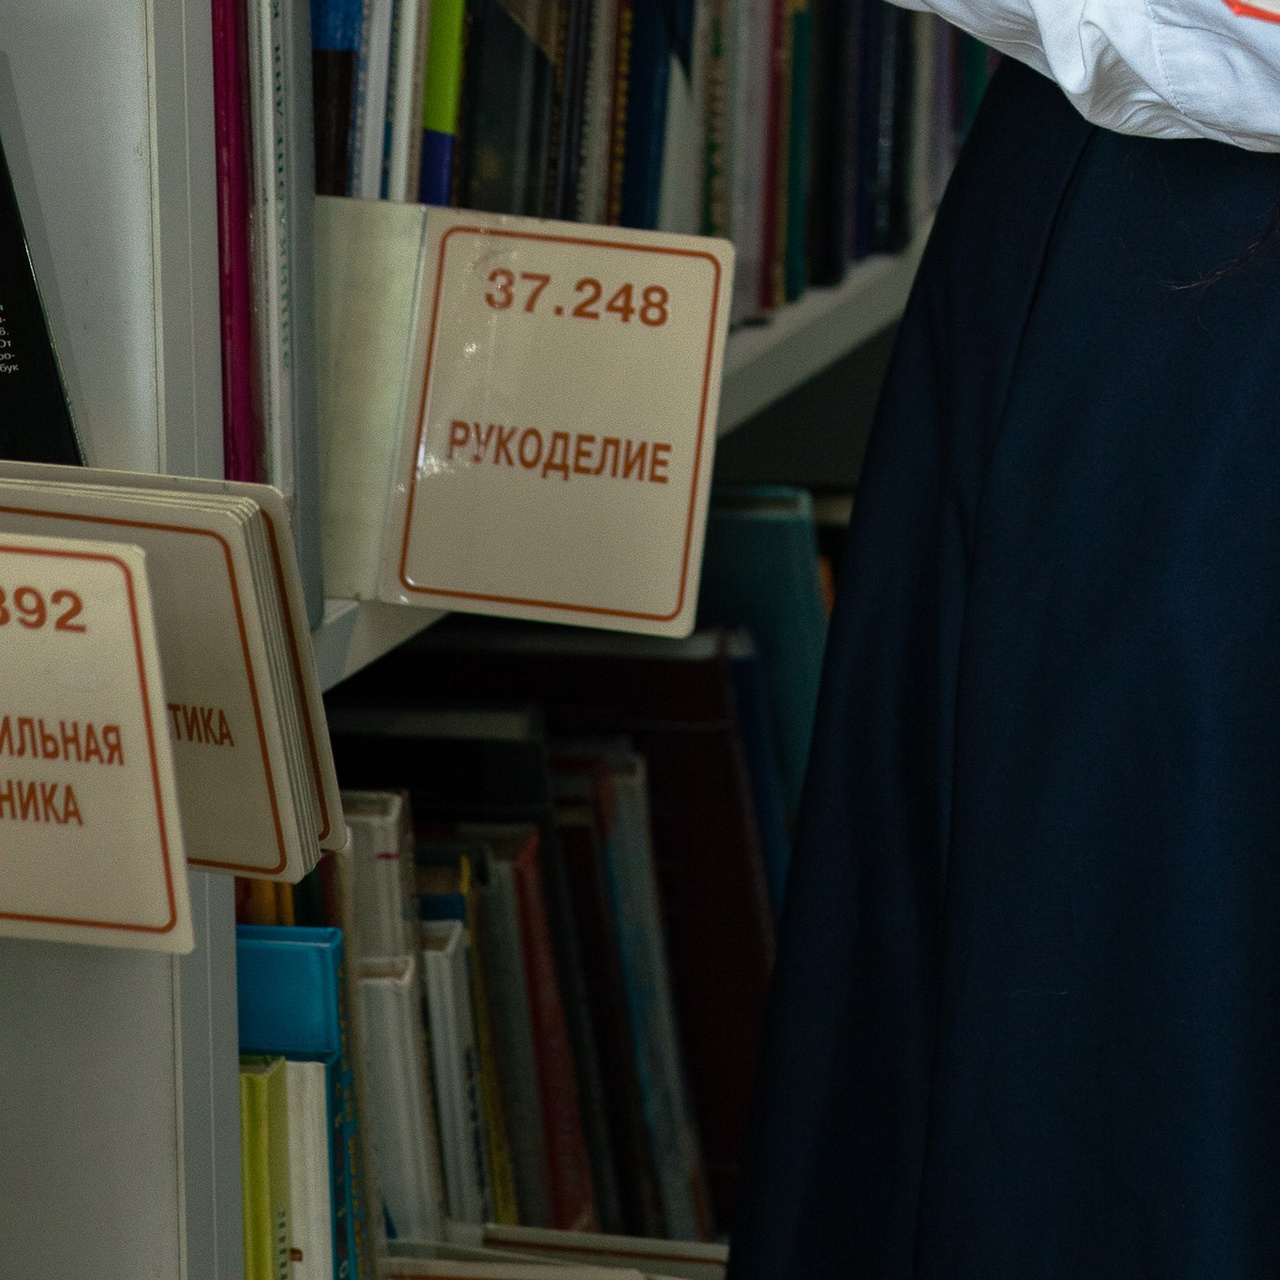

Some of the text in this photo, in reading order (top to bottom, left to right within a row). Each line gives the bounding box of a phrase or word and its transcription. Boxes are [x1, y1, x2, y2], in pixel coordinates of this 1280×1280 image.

[485, 268, 669, 328] 37.248
[449, 421, 671, 484] РУКОДЕЛИЕ
[167, 702, 235, 747] ТИКА
